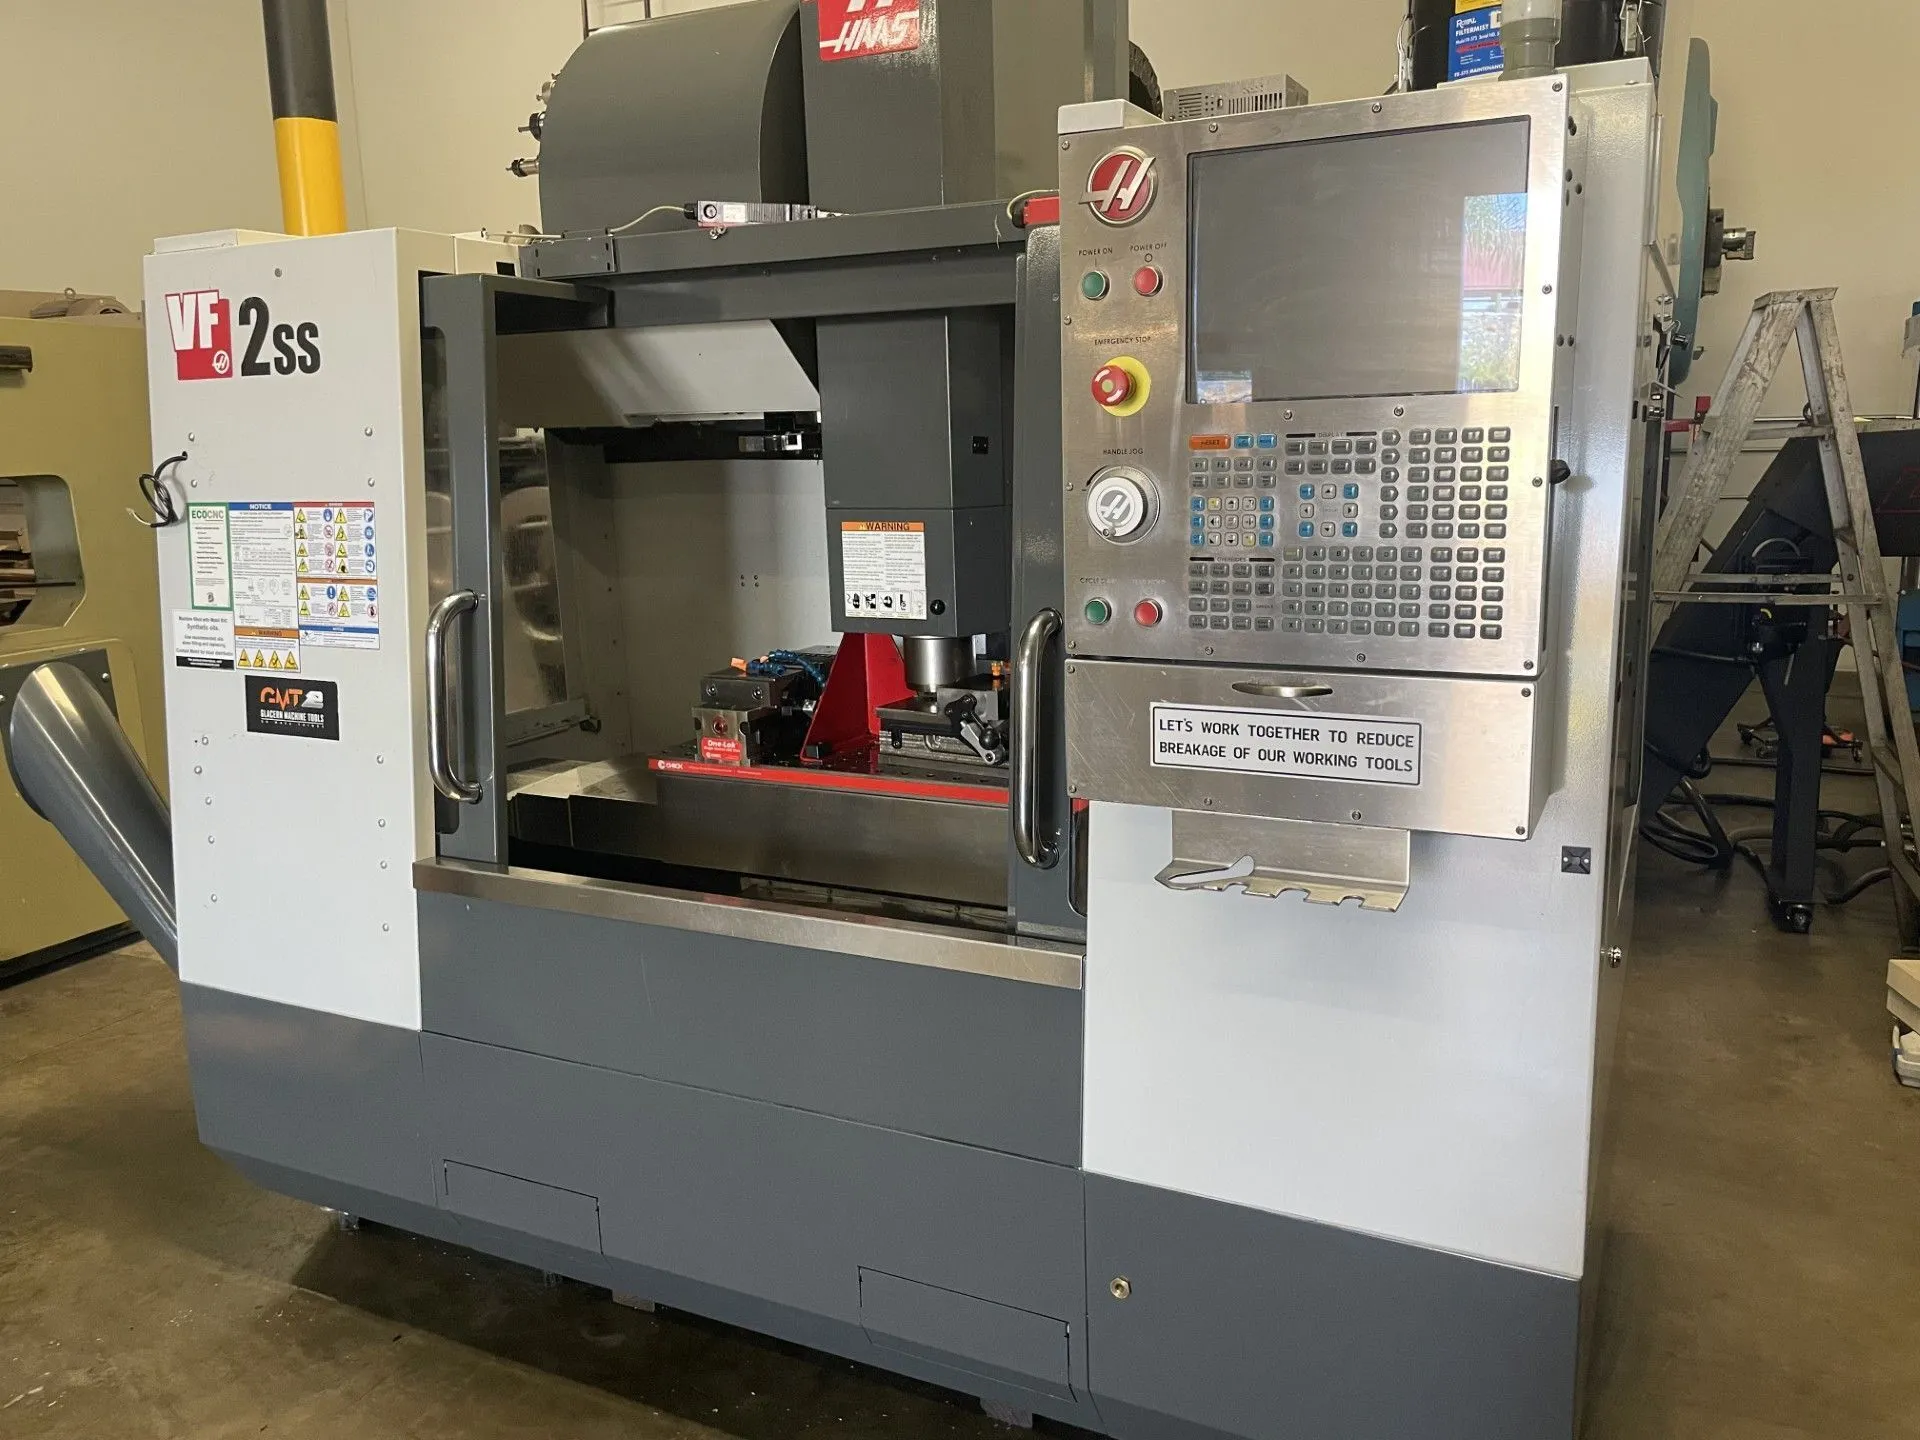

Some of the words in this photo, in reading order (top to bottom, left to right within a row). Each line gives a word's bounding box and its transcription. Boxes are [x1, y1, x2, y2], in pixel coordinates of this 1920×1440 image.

[820, 10, 919, 53] HAAS
[1455, 23, 1489, 37] FILTERMIST
[1078, 248, 1101, 256] POWER
[166, 292, 219, 350] VF
[1094, 337, 1134, 345] EMERGENCY
[1135, 336, 1151, 344] STOP
[866, 522, 910, 531] WARNING
[260, 687, 303, 711] GMT
[284, 711, 307, 721] MACHINE
[307, 713, 324, 723] TOOLS
[1159, 718, 1192, 732] LET'S
[1201, 722, 1240, 736] WORK
[1248, 724, 1320, 741] TOGETHER
[1328, 729, 1348, 743] TO
[1356, 732, 1414, 748] REDUCE
[707, 740, 736, 748] One-Lok
[1159, 742, 1226, 758] BREAKAGE
[1233, 747, 1251, 759] OF
[1257, 749, 1286, 762] OUR
[1293, 752, 1357, 768] WORKING
[1365, 756, 1413, 772] TOOLS
